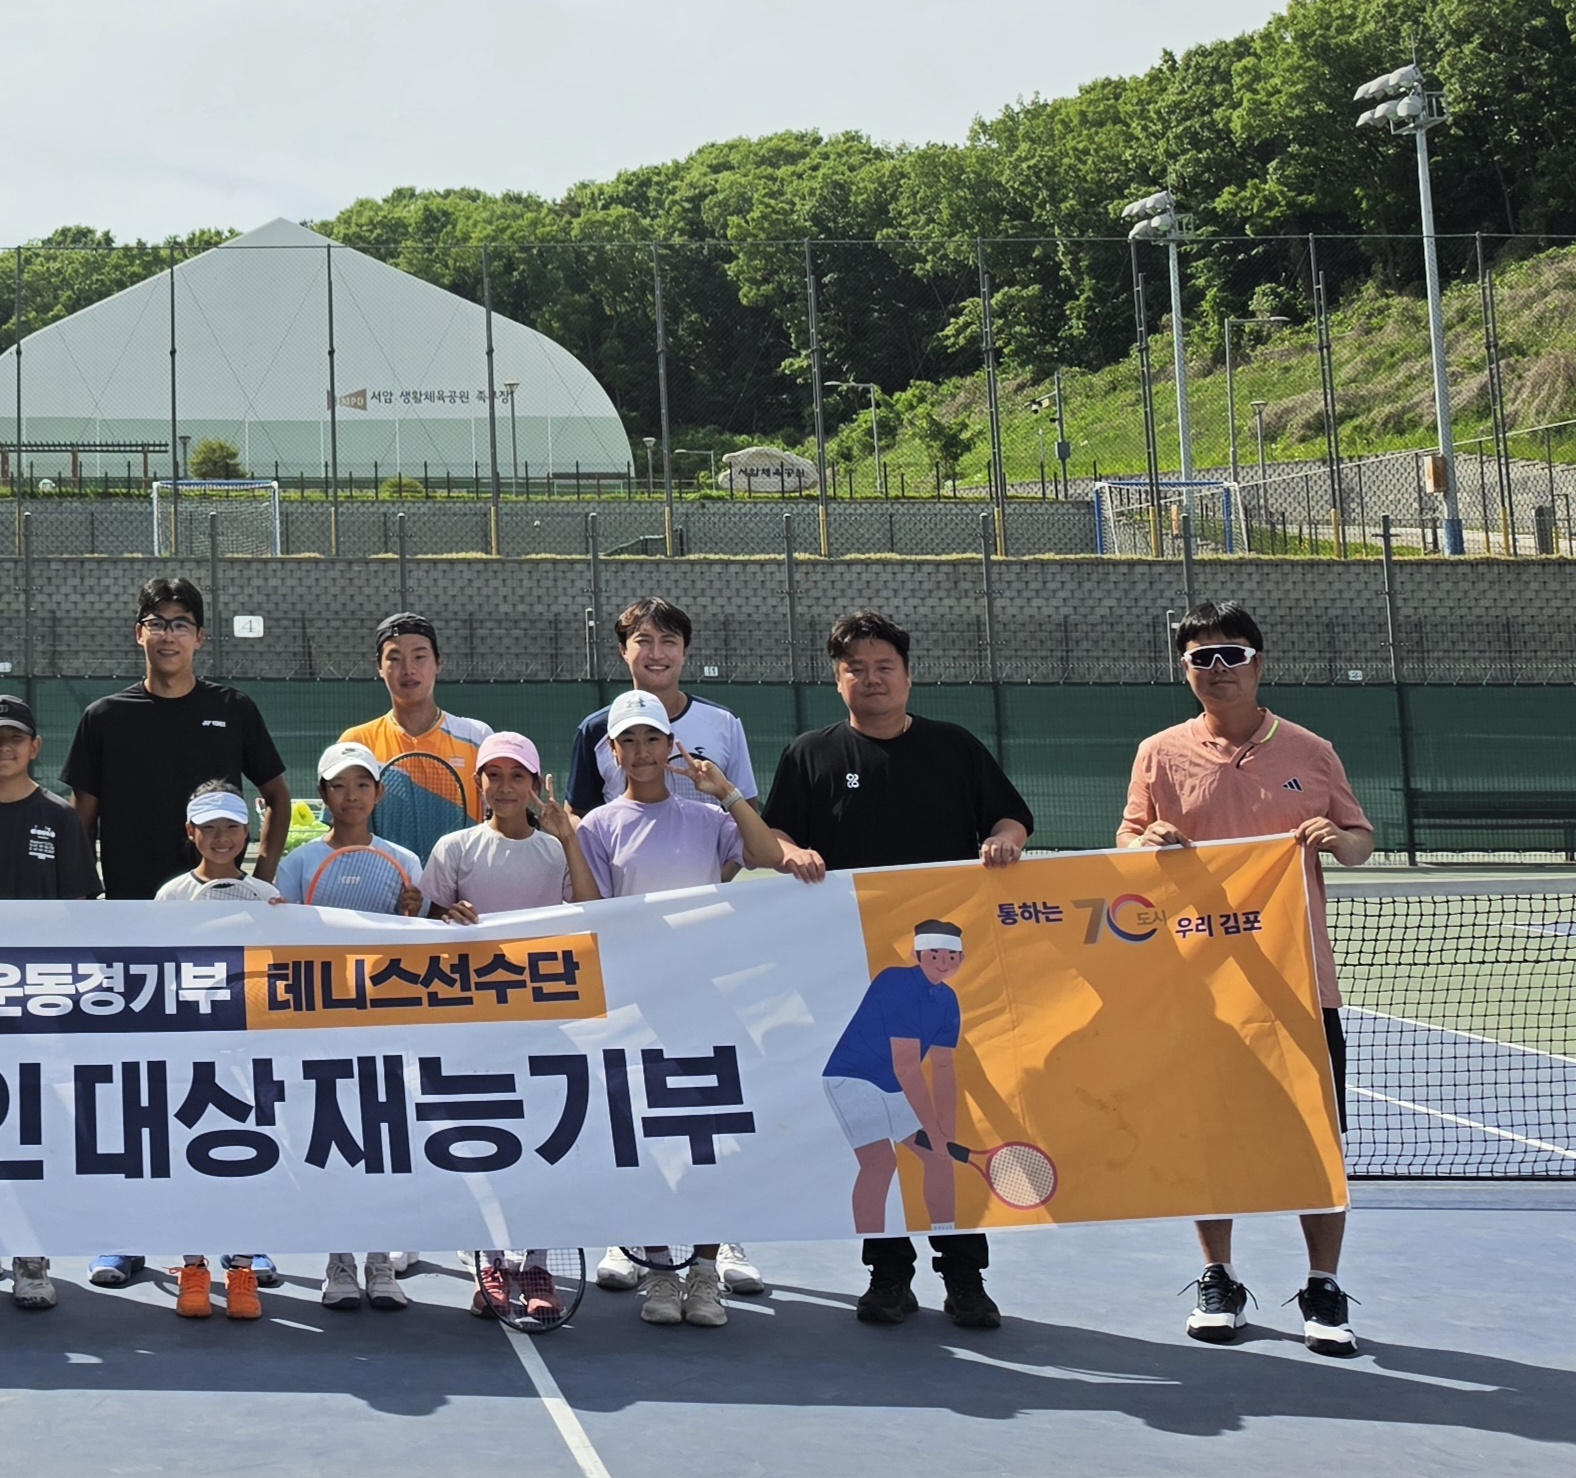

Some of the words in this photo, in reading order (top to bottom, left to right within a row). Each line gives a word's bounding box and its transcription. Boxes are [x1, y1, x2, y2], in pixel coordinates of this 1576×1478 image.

[371, 390, 394, 404] 서암
[399, 390, 470, 404] 생활체육공원
[476, 390, 510, 404] 족장
[240, 619, 256, 633] 4
[997, 901, 1064, 926] 통하는
[1136, 909, 1169, 928] 도시
[1175, 914, 1215, 938] 우리
[1219, 910, 1264, 936] 김포
[267, 949, 580, 1012] 테니스선수단
[73, 1057, 286, 1180] 대상
[302, 1044, 757, 1175] 재능기부
